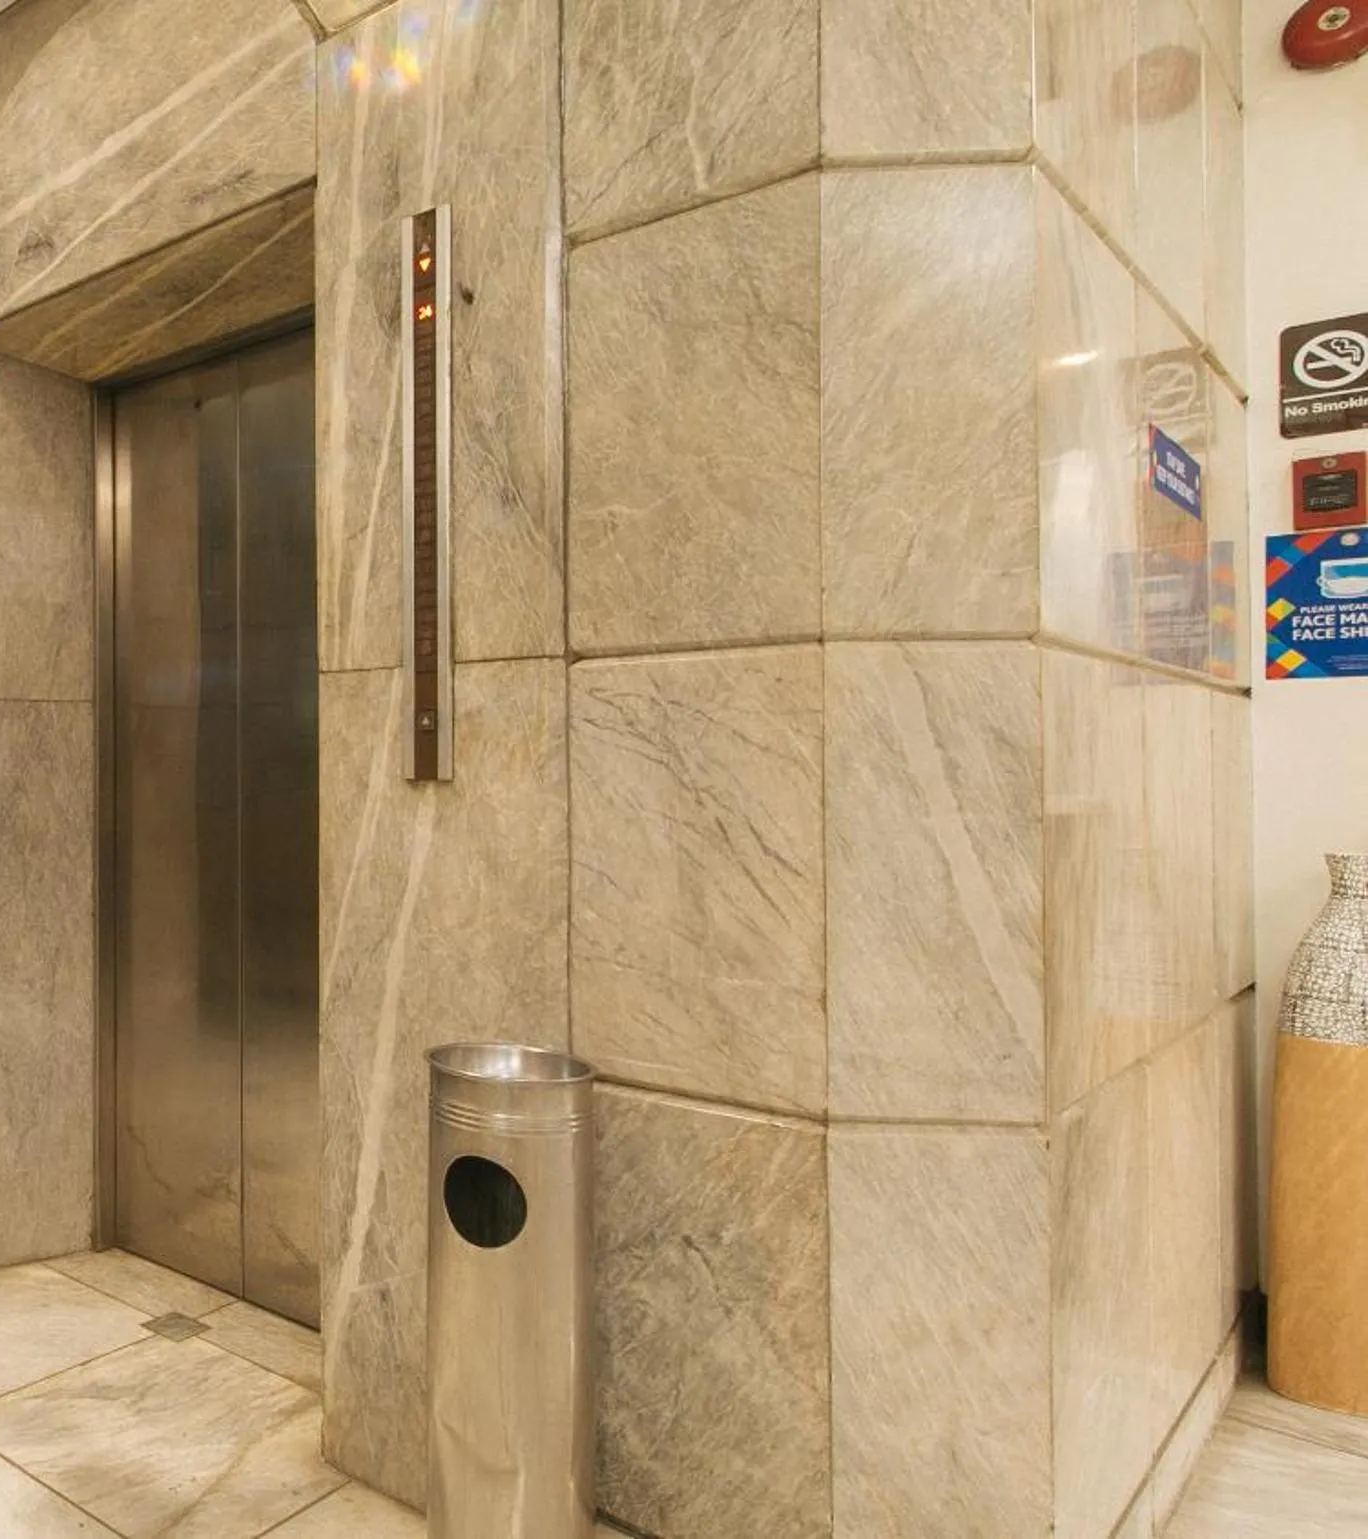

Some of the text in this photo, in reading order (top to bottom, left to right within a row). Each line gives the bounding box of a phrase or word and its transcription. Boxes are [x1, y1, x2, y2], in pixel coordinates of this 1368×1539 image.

[1284, 405, 1308, 419] No
[1300, 605, 1335, 614] PLEASE
[1292, 613, 1336, 628] FACE
[1292, 626, 1336, 641] FACE
